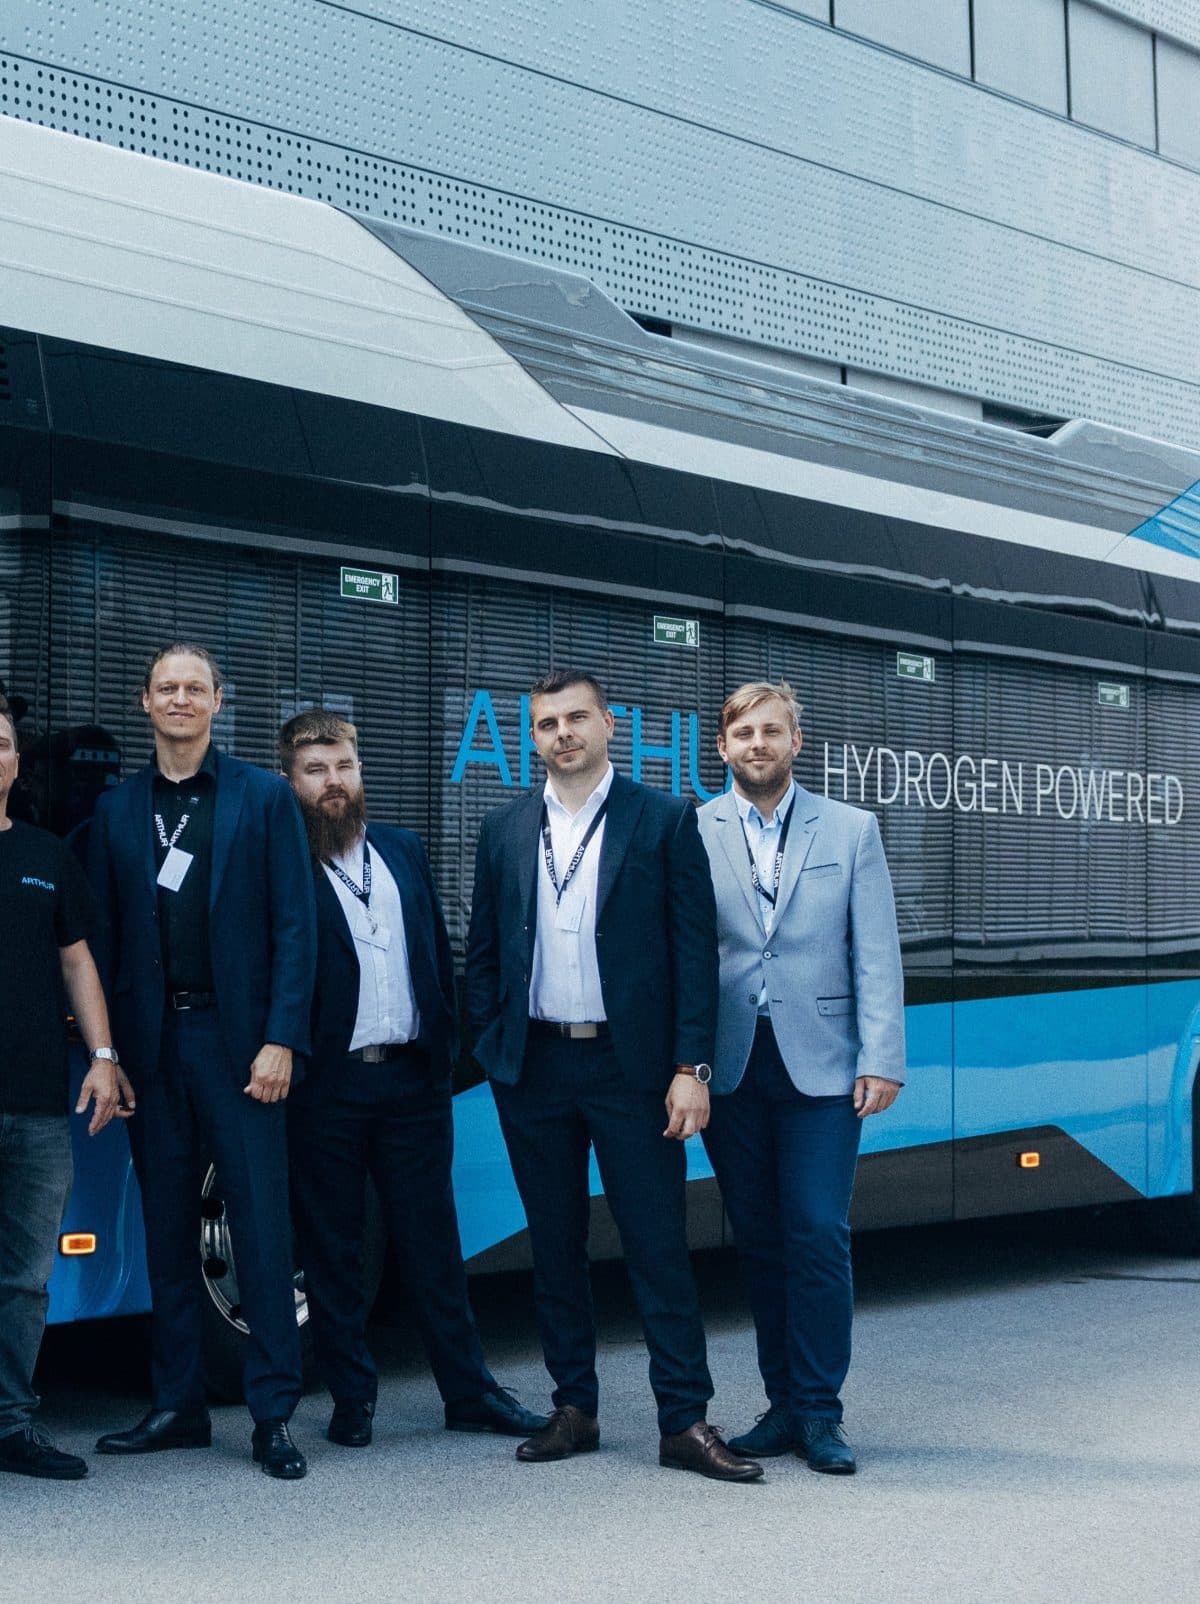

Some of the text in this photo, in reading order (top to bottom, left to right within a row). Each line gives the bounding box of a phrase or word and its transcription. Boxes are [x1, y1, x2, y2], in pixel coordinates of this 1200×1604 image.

[345, 574, 380, 587] EMERGENCY
[356, 584, 369, 594] EXIT
[657, 622, 685, 632] EMERGENCY
[824, 742, 1184, 825] HYDROGEN POWERED
[154, 814, 169, 847] ARTHUR
[168, 814, 190, 847] ARTHUR
[362, 862, 371, 894] ARTHUR
[563, 845, 585, 881] ARTHUR
[772, 852, 784, 888] ARTHUR
[21, 876, 55, 891] ARTHUR
[334, 868, 362, 896] ARTHUR
